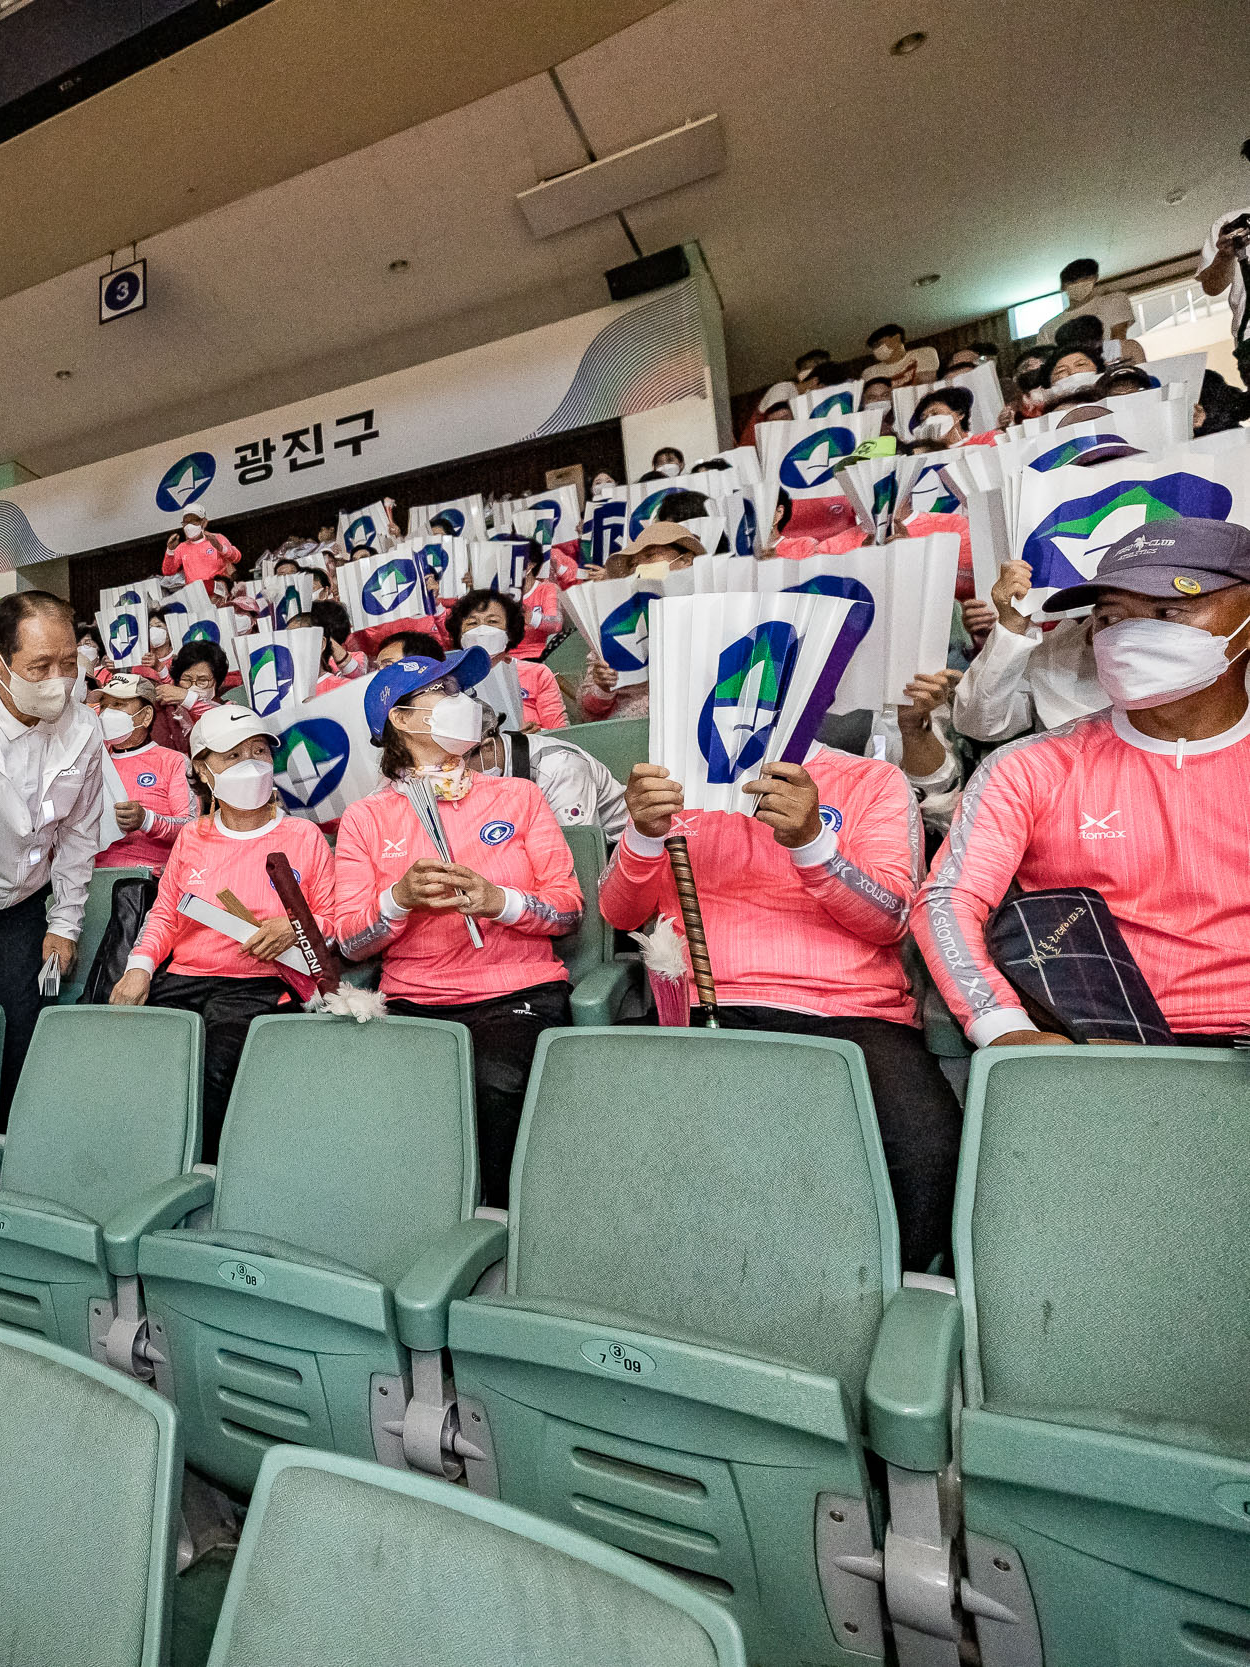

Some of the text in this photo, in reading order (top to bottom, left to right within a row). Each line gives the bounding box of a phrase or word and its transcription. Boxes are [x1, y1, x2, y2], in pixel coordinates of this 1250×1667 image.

[116, 281, 129, 301] 3
[234, 409, 379, 485] 광진구
[1078, 829, 1126, 840] stomax
[856, 875, 898, 911] stomax
[933, 916, 966, 970] stomax
